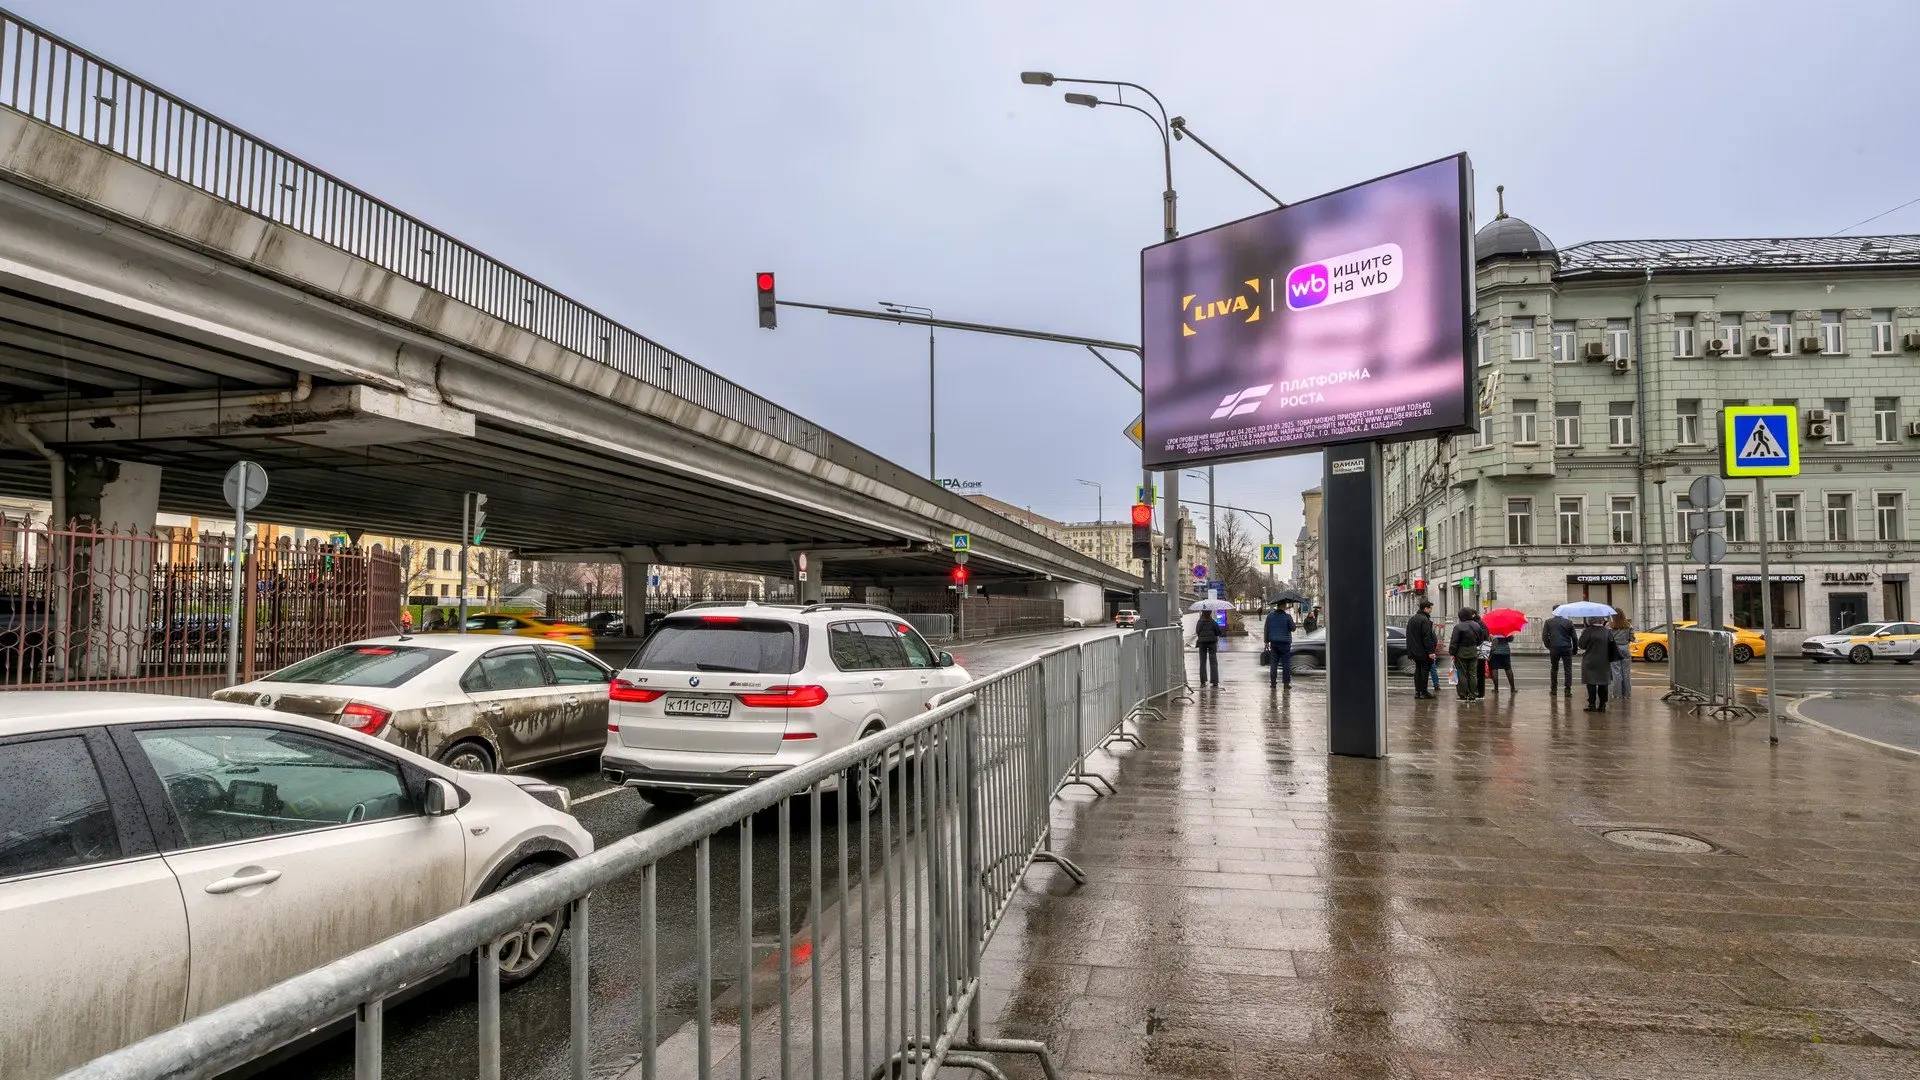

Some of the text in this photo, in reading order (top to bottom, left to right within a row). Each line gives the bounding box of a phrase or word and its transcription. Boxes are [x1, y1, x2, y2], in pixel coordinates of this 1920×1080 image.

[1333, 254, 1392, 278] ищите
[1291, 273, 1326, 297] wb
[1334, 270, 1388, 294] на wb
[1195, 295, 1249, 321] LIVA
[1280, 367, 1371, 393] ПЛАТФОРМА
[1280, 392, 1325, 409] РОСТА
[1179, 434, 1209, 443] ПРОВЕДЕНИЯ
[1209, 431, 1226, 439] АКЦИИ
[1230, 426, 1257, 436] 01.04.2025
[1297, 418, 1315, 427] ТОВАР
[1315, 415, 1336, 424] МОЖНО
[1337, 409, 1374, 421] ПРИОБРЕСТИ
[1375, 408, 1384, 416] ПО
[1385, 405, 1406, 414] АКЦИИ
[1407, 401, 1431, 411] ТОЛЬКО
[1210, 437, 1225, 445] ТОВАР
[1225, 434, 1248, 443] ИМЕЕТСЯ
[1280, 425, 1305, 434] НАЛИЧИЕ
[1305, 421, 1336, 432] УТОЧНЯЙТЕ
[1346, 417, 1364, 426] САЙТЕ
[1268, 432, 1303, 443] МОСКОВСКАЯ
[1371, 420, 1403, 430] КОЛЕДИНО
[962, 480, 982, 488] банк
[1825, 572, 1870, 581] FILLARY
[712, 700, 727, 710] 177
